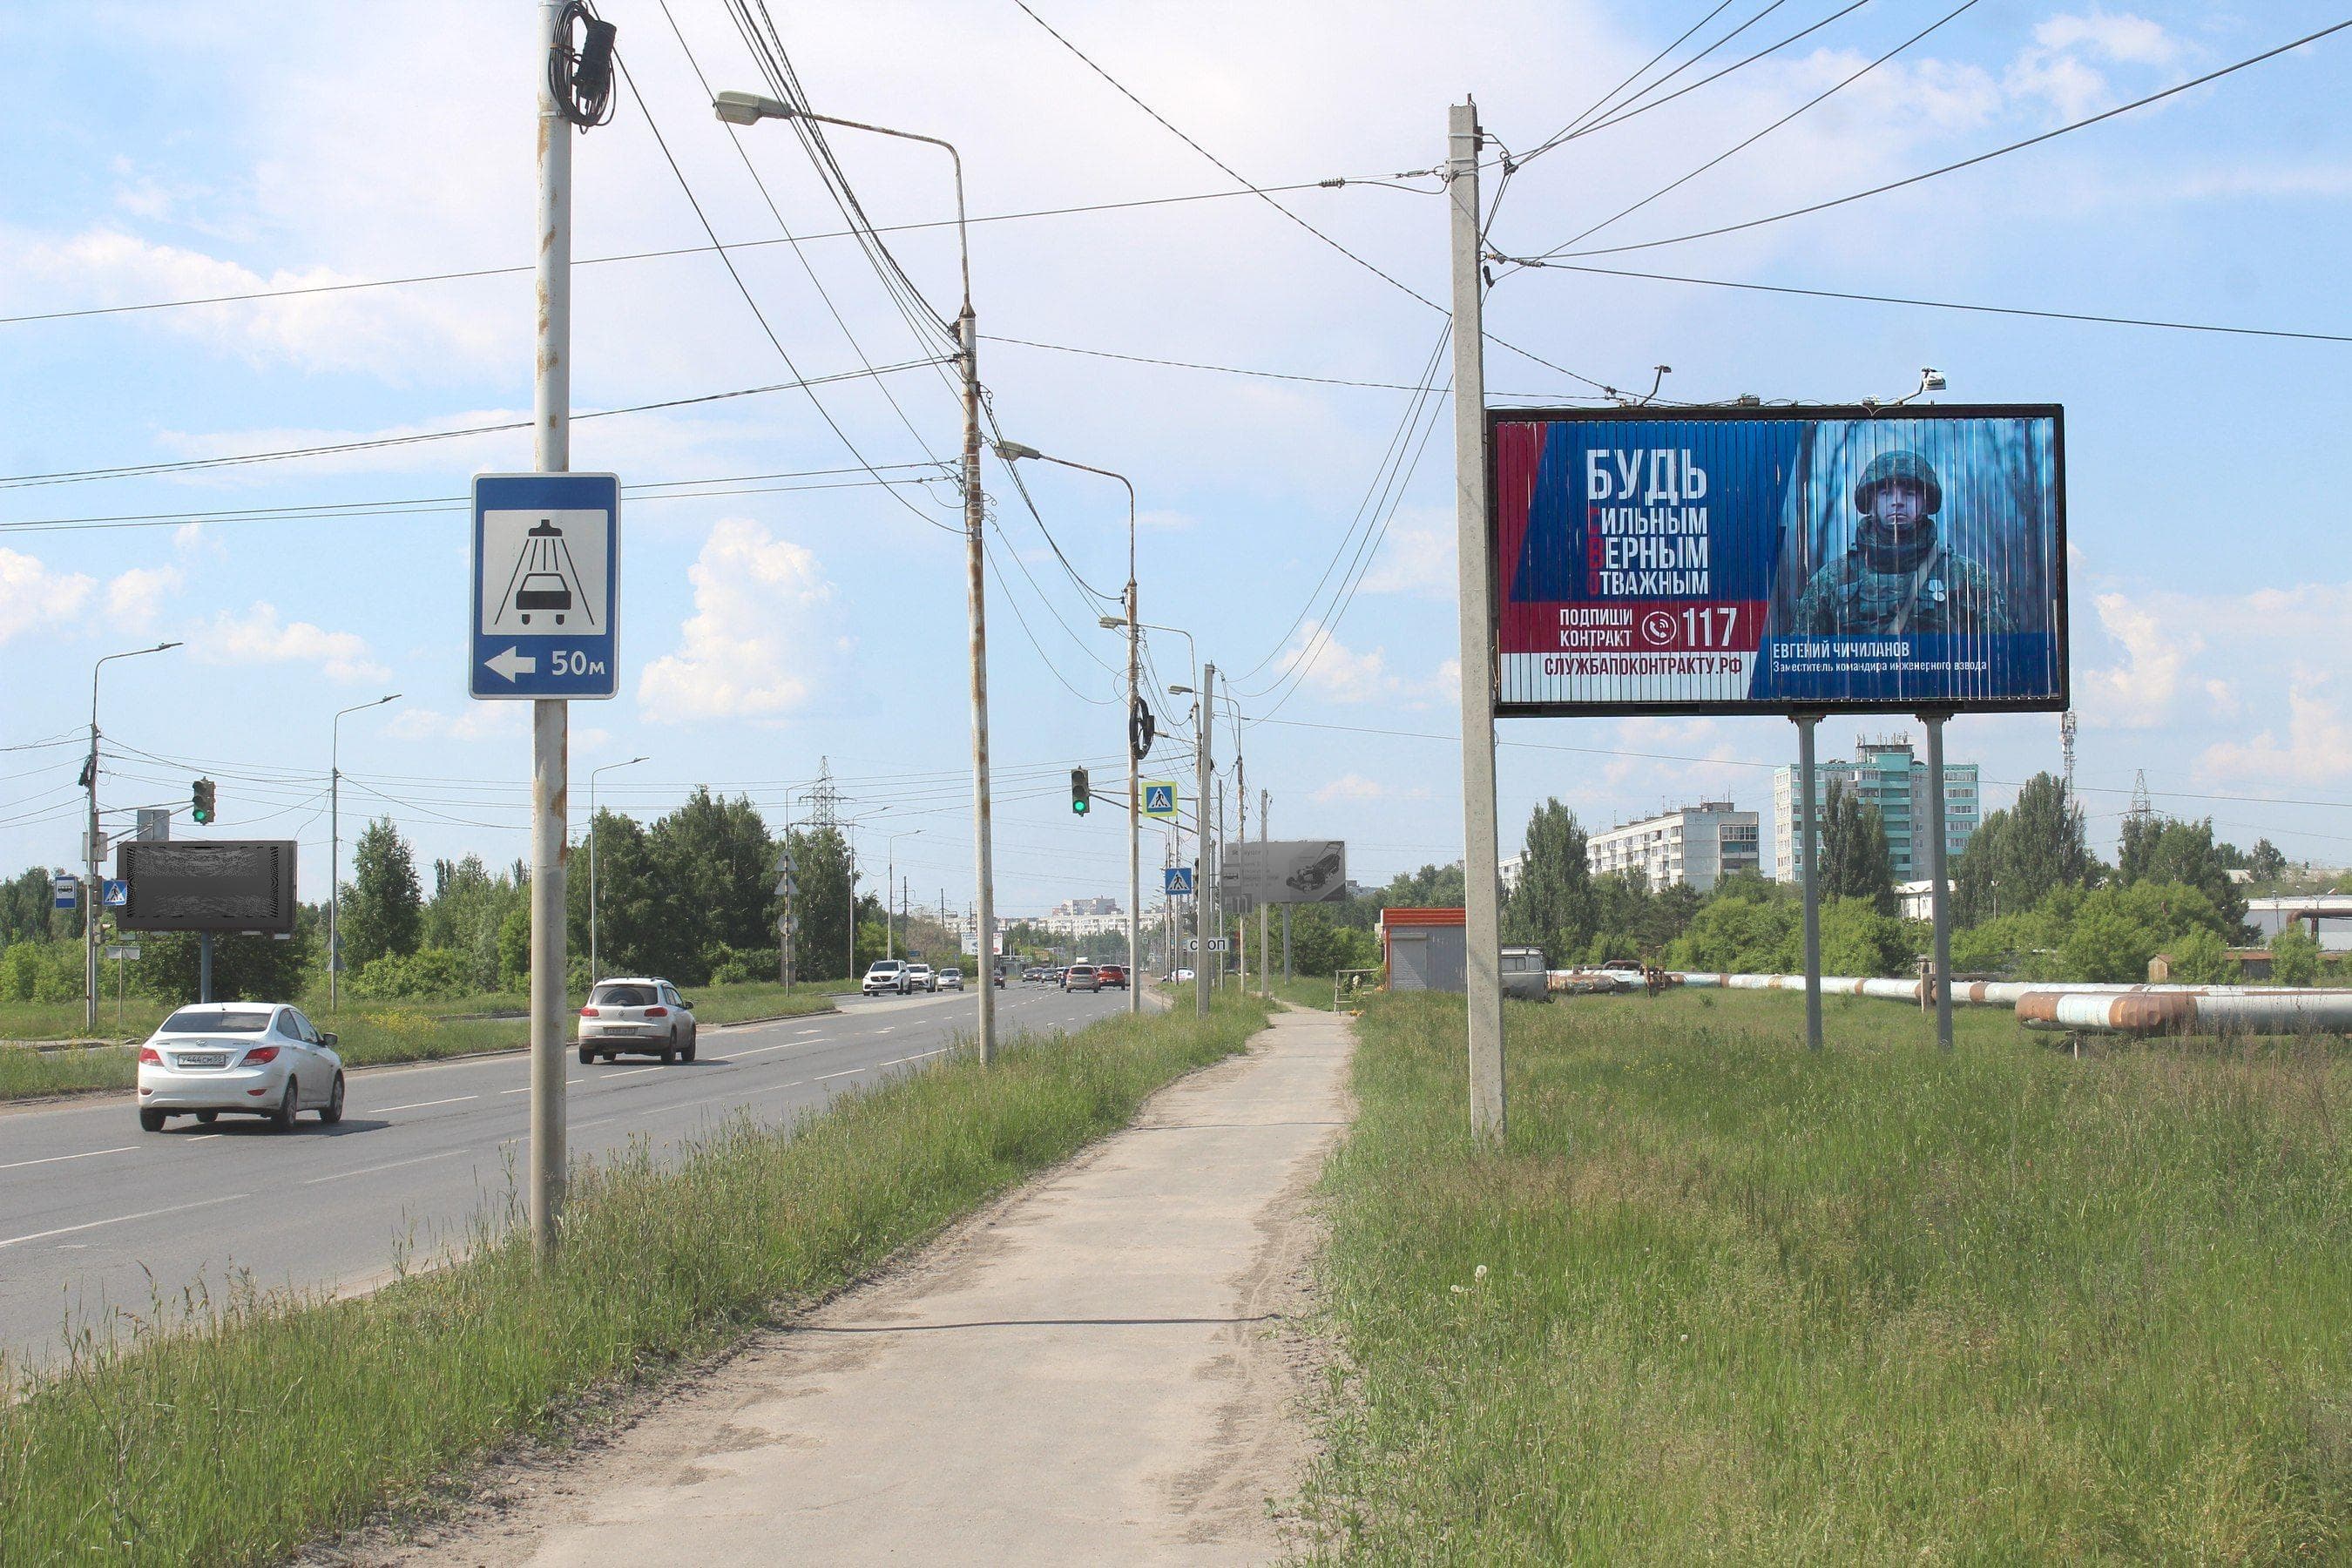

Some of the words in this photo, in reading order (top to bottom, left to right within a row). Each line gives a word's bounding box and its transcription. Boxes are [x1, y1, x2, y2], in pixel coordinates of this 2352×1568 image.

[1587, 449, 1707, 506] БУДЬ
[1587, 507, 1707, 535] СИЛЬНЫМ
[1588, 537, 1708, 569] ВЕРНЫМ
[1588, 571, 1708, 595] ОТВАЖНЫМ
[1559, 608, 1632, 627] ПОДПИШИ
[1682, 607, 1737, 646] 117
[1560, 630, 1632, 647] КОНТРАКТ
[1773, 640, 1829, 659] ЕВГЕНИЙ
[1833, 641, 1909, 657] ЧИЧИЛАНОВ
[1544, 657, 1742, 675] СЛУЖБАПОКОНТРАКТУ.РФ
[1773, 660, 1833, 672] Заместитель
[1835, 662, 1888, 673] командира
[1889, 661, 1951, 672] инженерного
[1954, 661, 1987, 672] взвода
[1190, 940, 1226, 950] СОП
